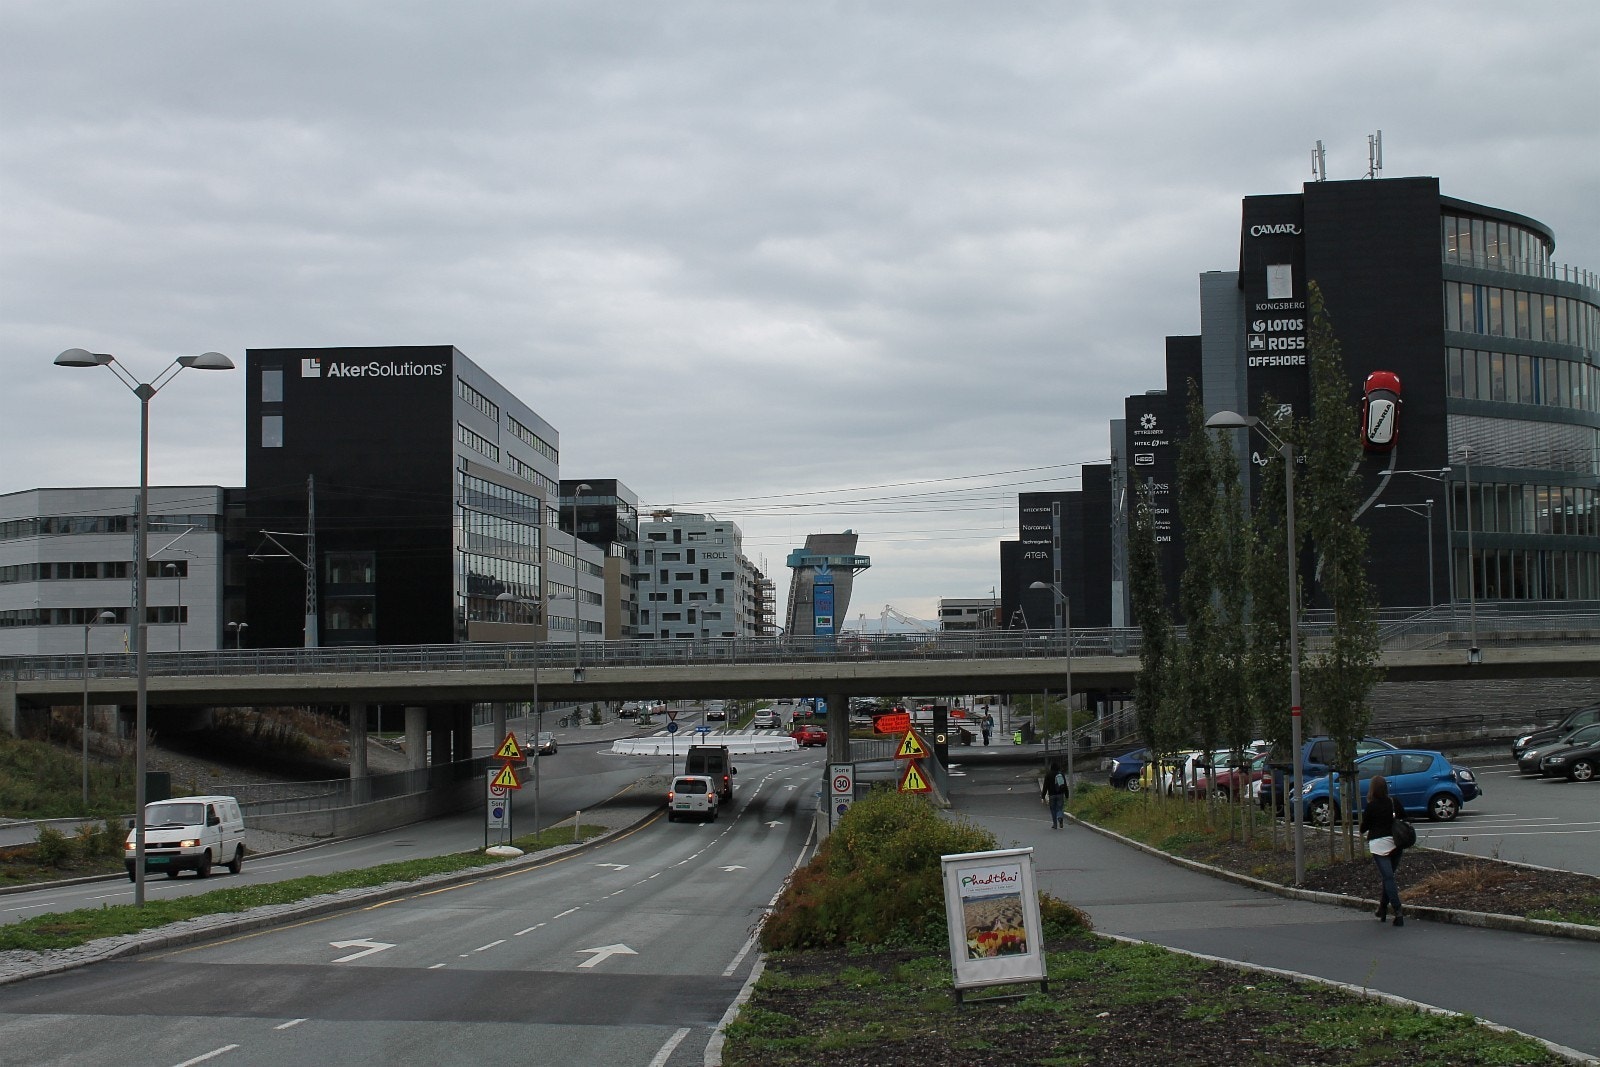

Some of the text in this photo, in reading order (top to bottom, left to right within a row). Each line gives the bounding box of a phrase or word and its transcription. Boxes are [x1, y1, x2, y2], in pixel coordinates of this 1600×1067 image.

[1250, 223, 1302, 237] CAMAR
[1255, 302, 1305, 311] KONGSBERG
[1267, 318, 1304, 332] LOTOS
[1268, 336, 1305, 351] ROSS
[1248, 355, 1306, 367] OFFSHORE
[1370, 404, 1392, 439] BAVARIA
[701, 551, 728, 560] TROLL
[837, 779, 848, 789] 30
[961, 871, 1018, 888] Phadthai
